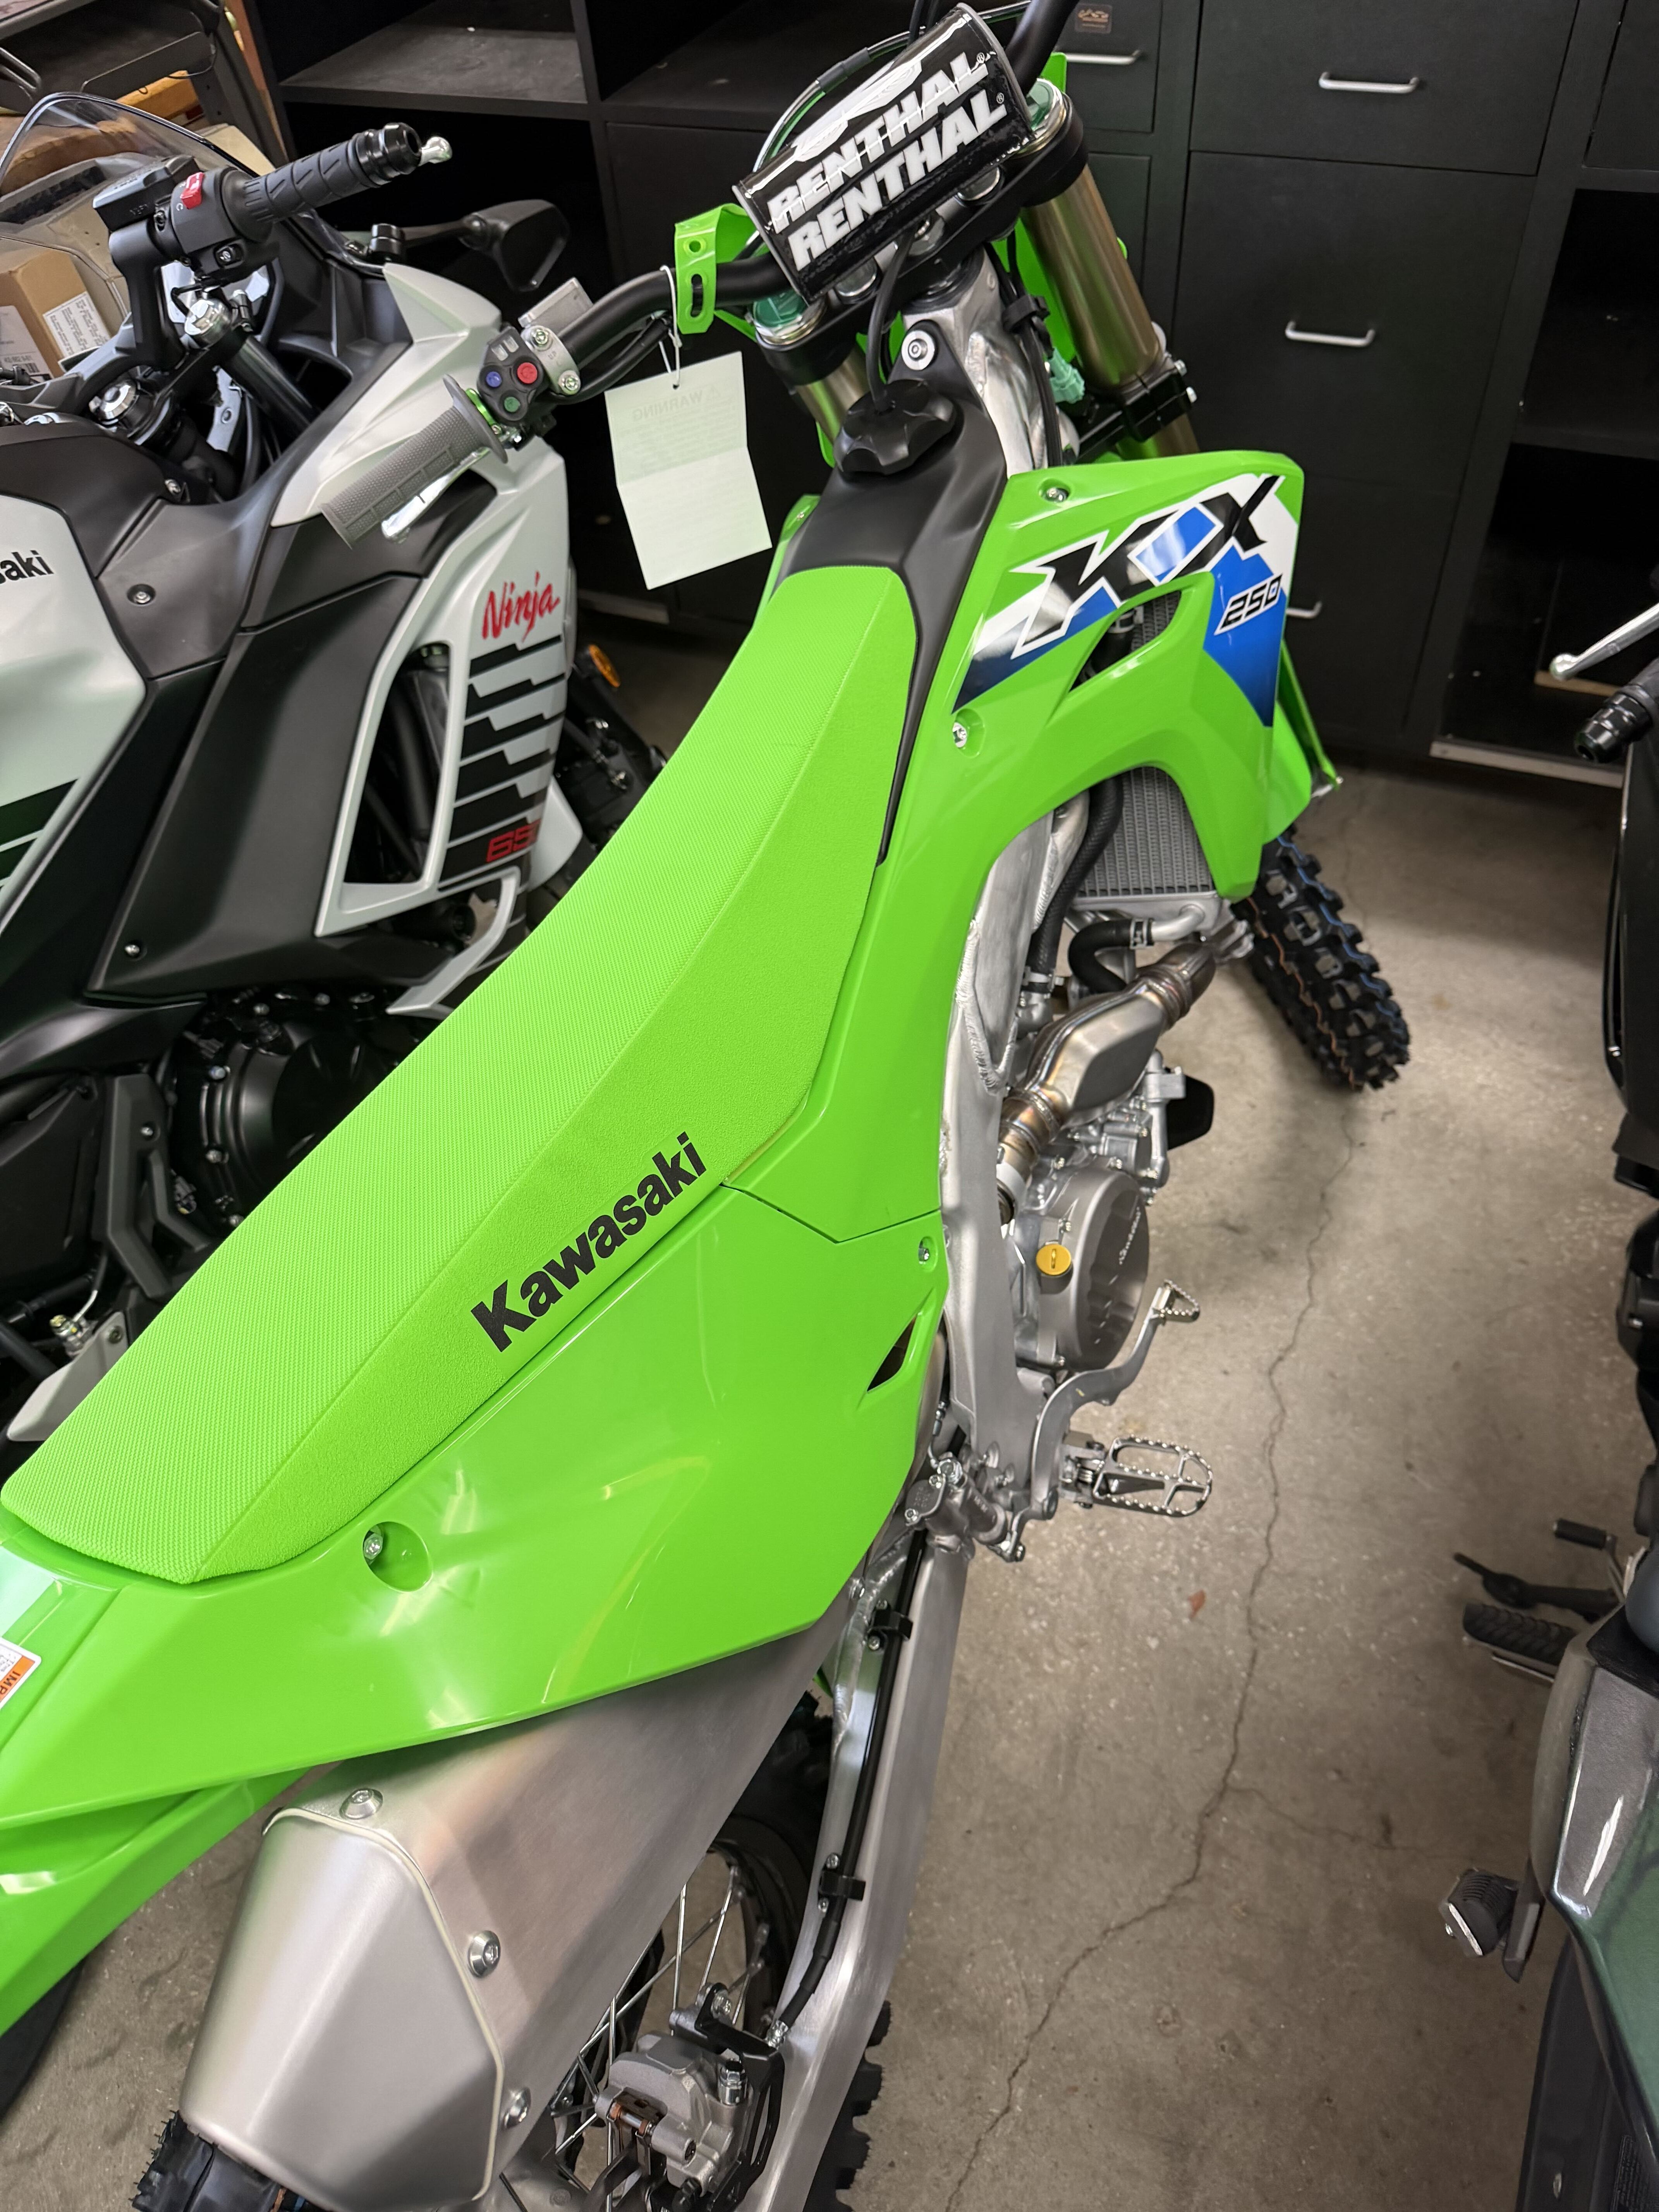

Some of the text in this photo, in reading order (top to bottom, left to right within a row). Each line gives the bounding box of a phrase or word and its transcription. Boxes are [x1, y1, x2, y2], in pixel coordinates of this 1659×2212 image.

[767, 51, 989, 234] RENTHAL
[787, 89, 1008, 272] RENTHAL
[0, 550, 54, 585] aki
[481, 571, 561, 642] Ninja
[1015, 475, 1285, 651] KX
[1219, 573, 1283, 630] 250
[470, 1130, 707, 1353] Kawasaki
